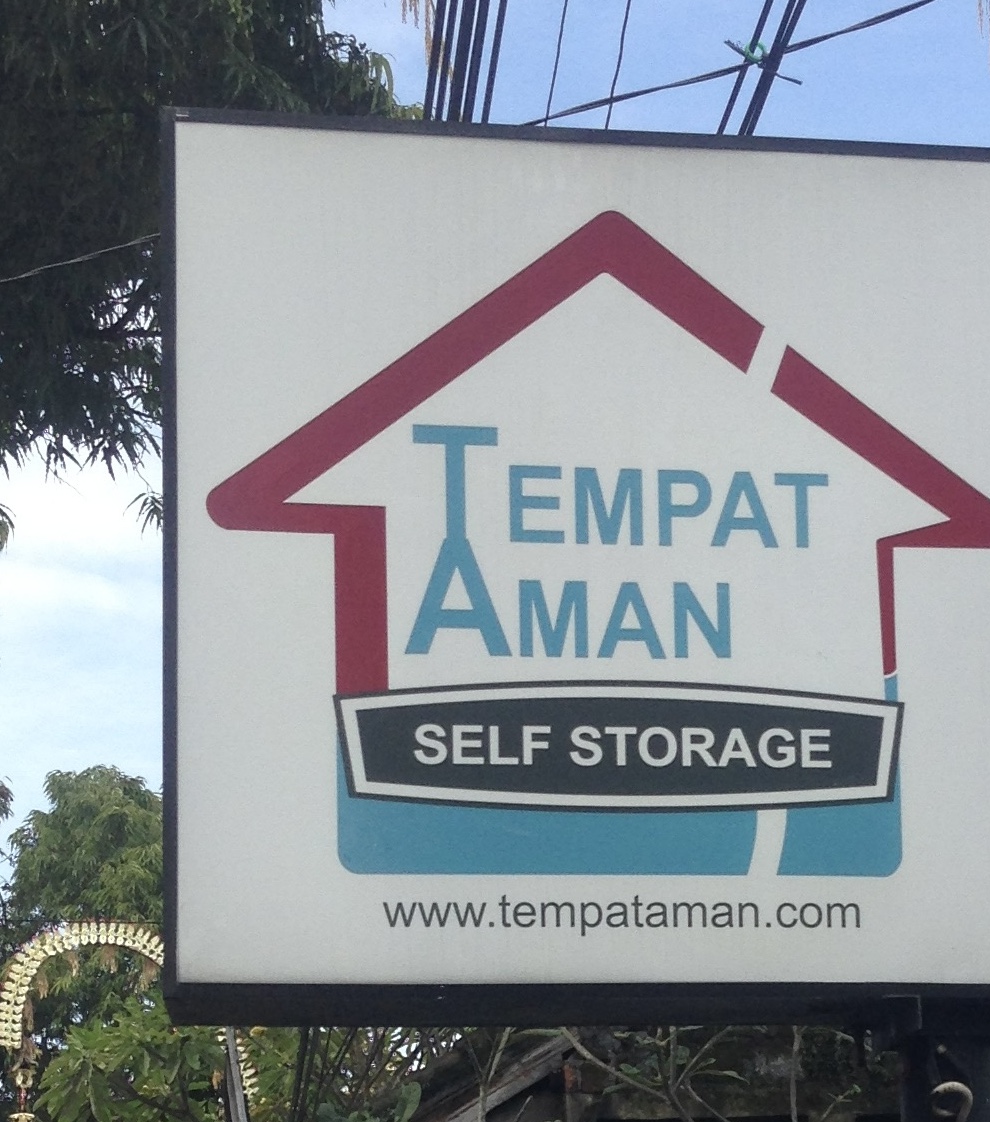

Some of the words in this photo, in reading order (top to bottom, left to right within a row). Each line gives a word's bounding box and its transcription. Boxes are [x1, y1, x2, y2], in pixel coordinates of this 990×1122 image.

[412, 424, 829, 549] TEMPAT
[404, 537, 732, 660] AMAN
[413, 723, 552, 767] SELF
[569, 726, 833, 769] STORAGE
[382, 894, 862, 937] www.tempataman.com
